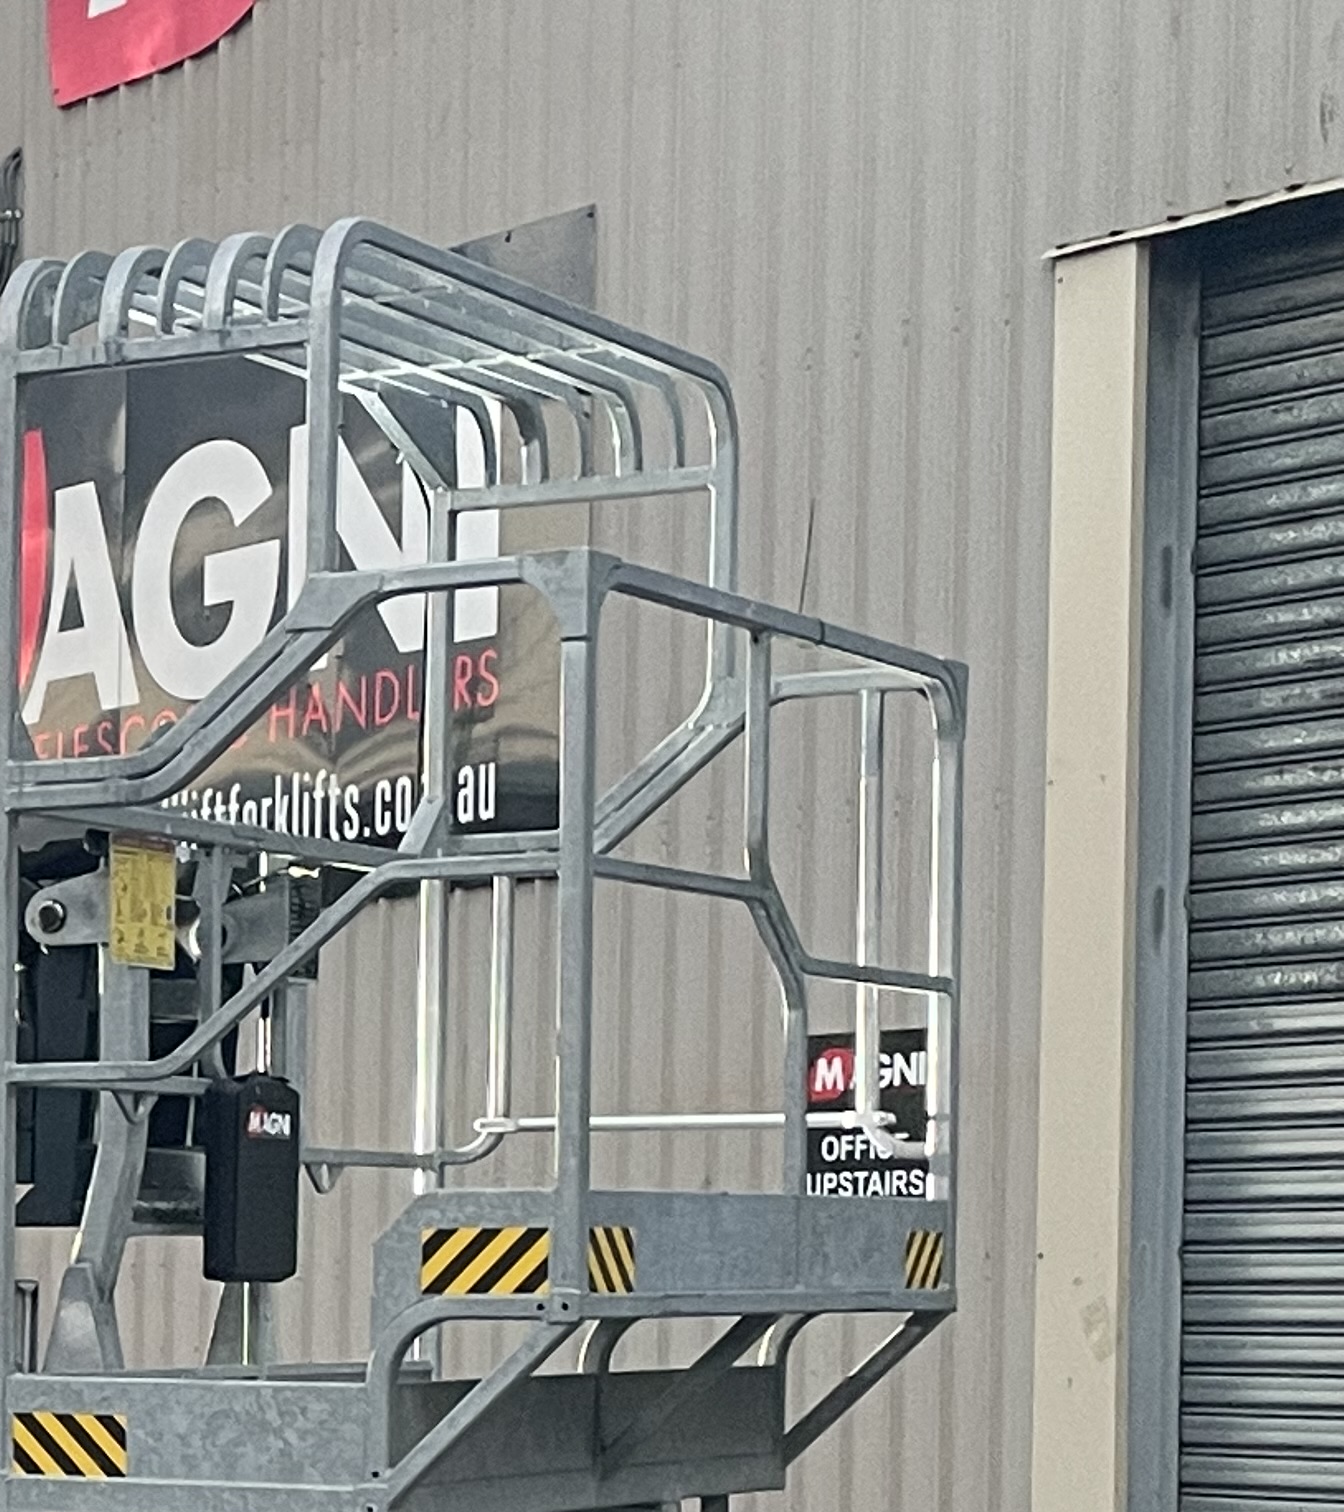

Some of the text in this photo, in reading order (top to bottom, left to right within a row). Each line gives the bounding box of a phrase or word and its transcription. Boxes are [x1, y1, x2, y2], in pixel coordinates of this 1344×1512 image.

[269, 649, 500, 743] HANDLRS
[814, 1051, 926, 1092] MGNI
[821, 1133, 910, 1162] OFFI
[806, 1169, 925, 1198] UPSTAIRS
